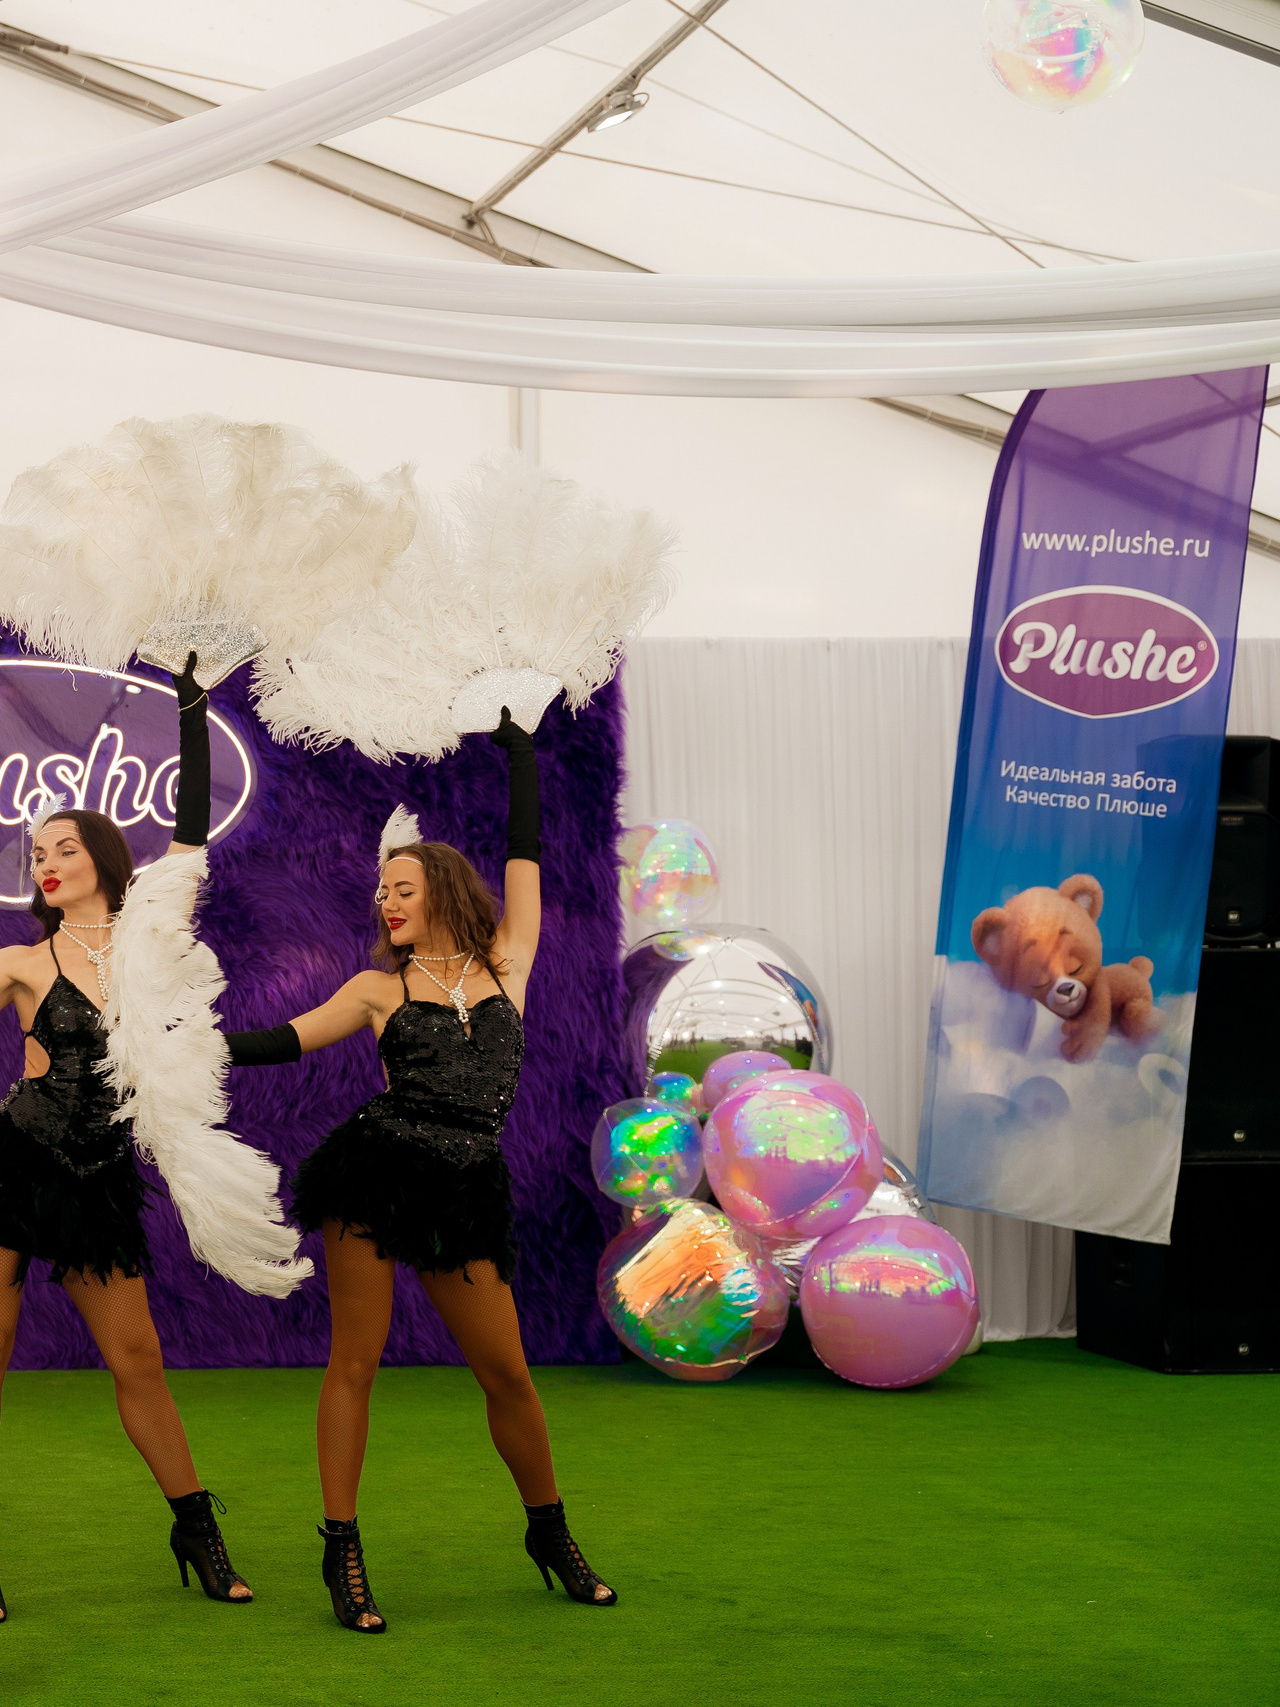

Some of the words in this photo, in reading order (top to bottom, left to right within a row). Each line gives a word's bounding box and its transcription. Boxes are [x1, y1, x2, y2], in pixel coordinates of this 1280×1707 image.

[1022, 528, 1210, 558] www.plushe.ru
[1000, 759, 1106, 786] Идеальная
[1110, 770, 1177, 793] забота
[1005, 785, 1090, 810] Качество
[1096, 793, 1168, 818] Плюше
